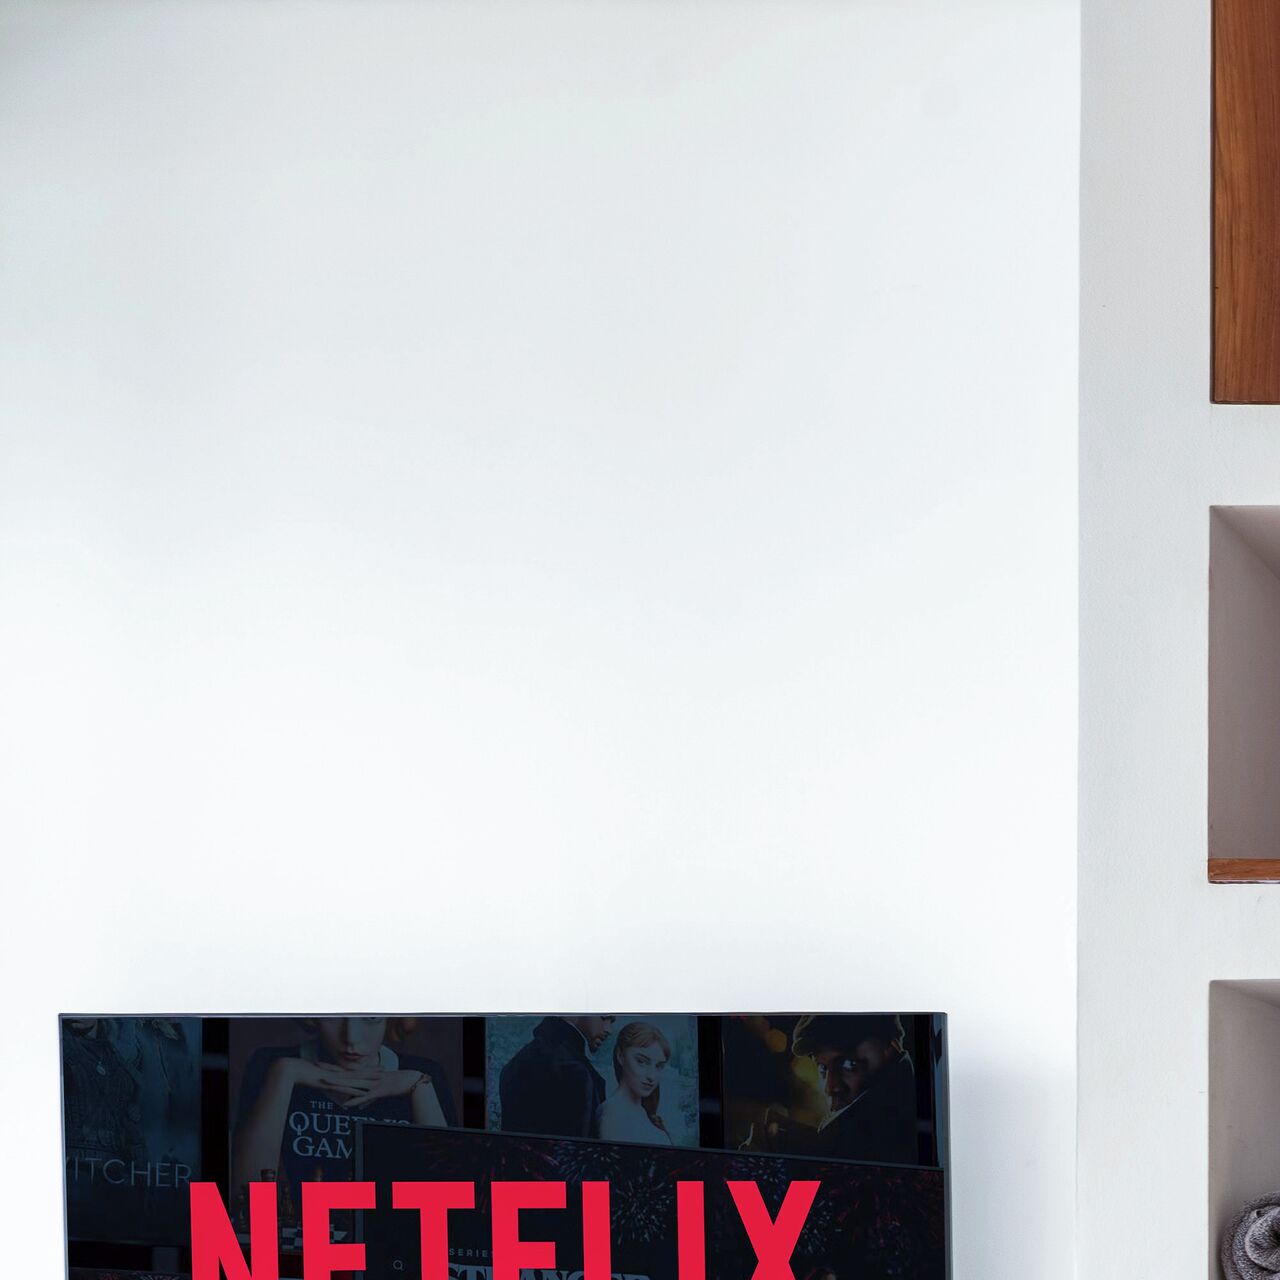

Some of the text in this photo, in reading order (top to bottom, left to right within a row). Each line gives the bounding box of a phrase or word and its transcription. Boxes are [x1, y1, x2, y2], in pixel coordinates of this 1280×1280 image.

[309, 1100, 334, 1110] THE
[66, 1156, 192, 1188] ITCHER
[448, 1248, 494, 1258] SERIE
